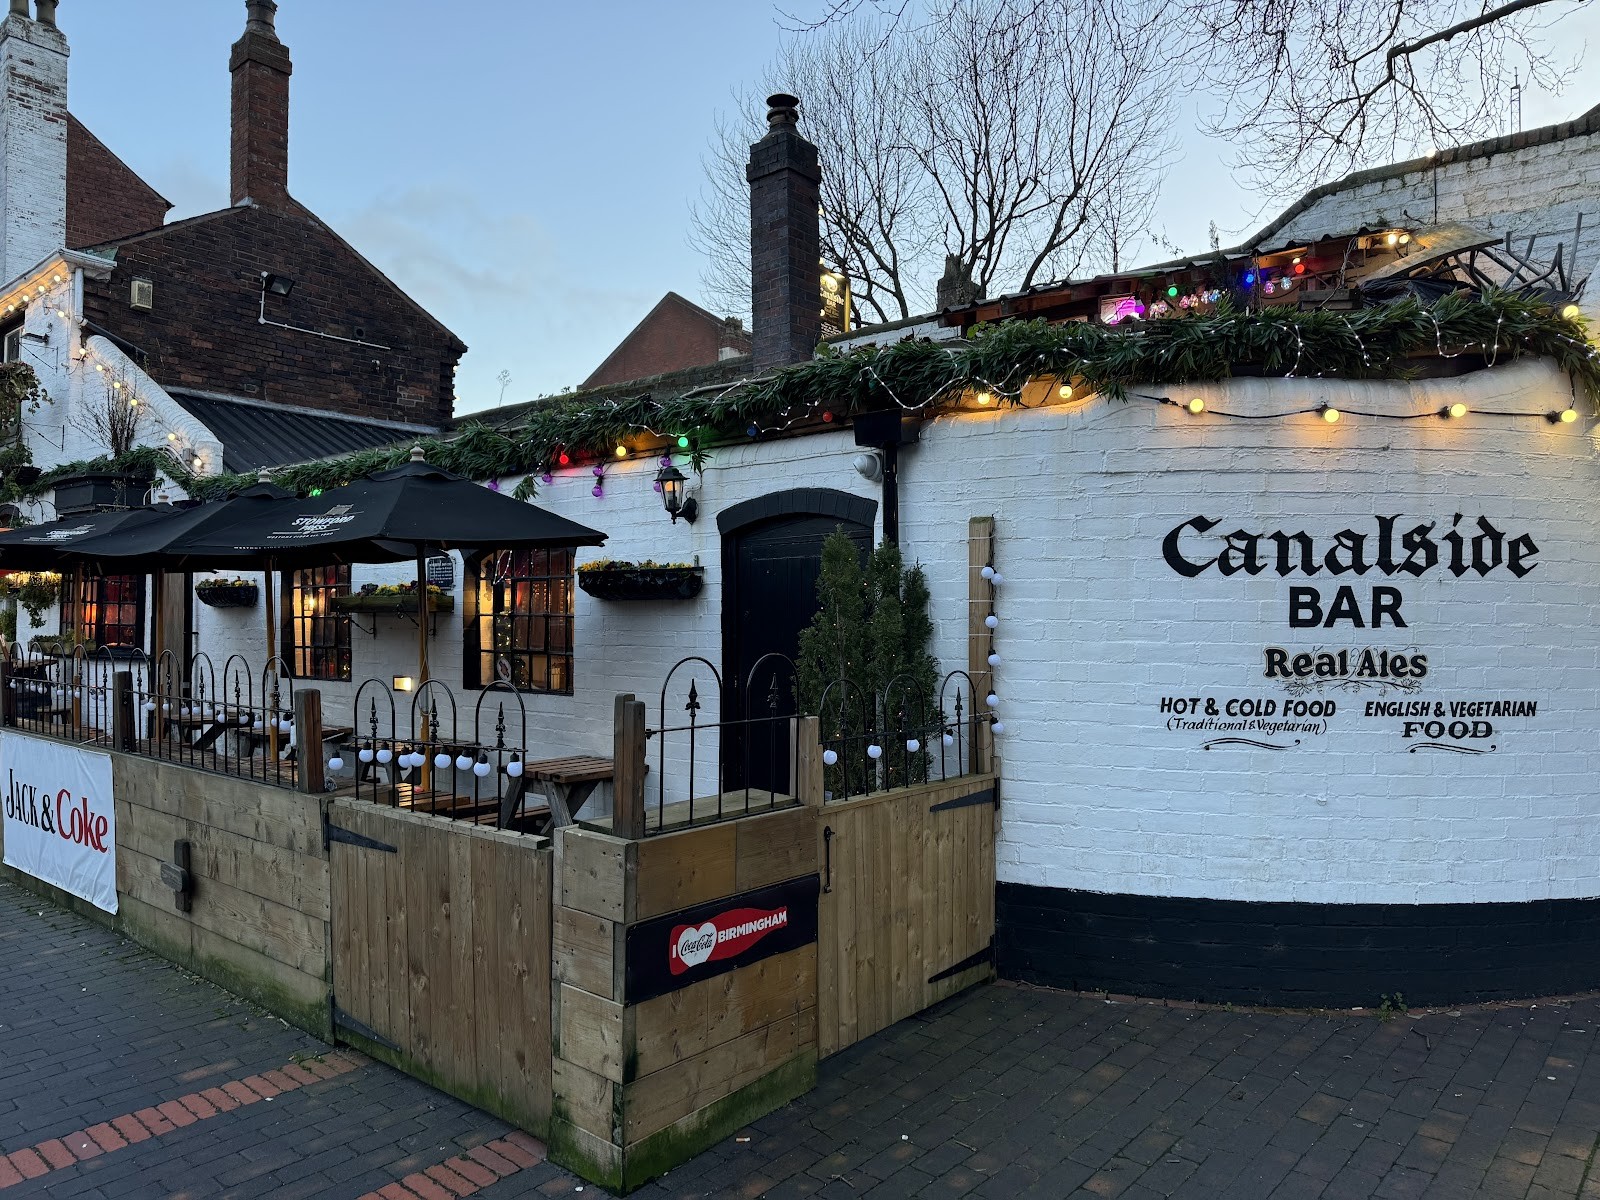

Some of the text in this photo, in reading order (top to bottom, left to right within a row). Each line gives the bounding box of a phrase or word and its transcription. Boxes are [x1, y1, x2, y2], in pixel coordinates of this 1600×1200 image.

[291, 515, 355, 526] STOWFORD
[1162, 513, 1540, 578] Canalside
[1289, 585, 1409, 628] BAR
[1264, 647, 1428, 678] Real Ales
[1160, 697, 1337, 717] HOT & COLD FOOD
[1364, 700, 1538, 718] ENGLISH & VEGETARIAN
[1167, 715, 1327, 736] (Traditional & Vegetarian)
[1402, 720, 1493, 739] FOOD
[6, 768, 109, 854] JACK & Coke
[717, 910, 788, 944] BIRMINGHAM
